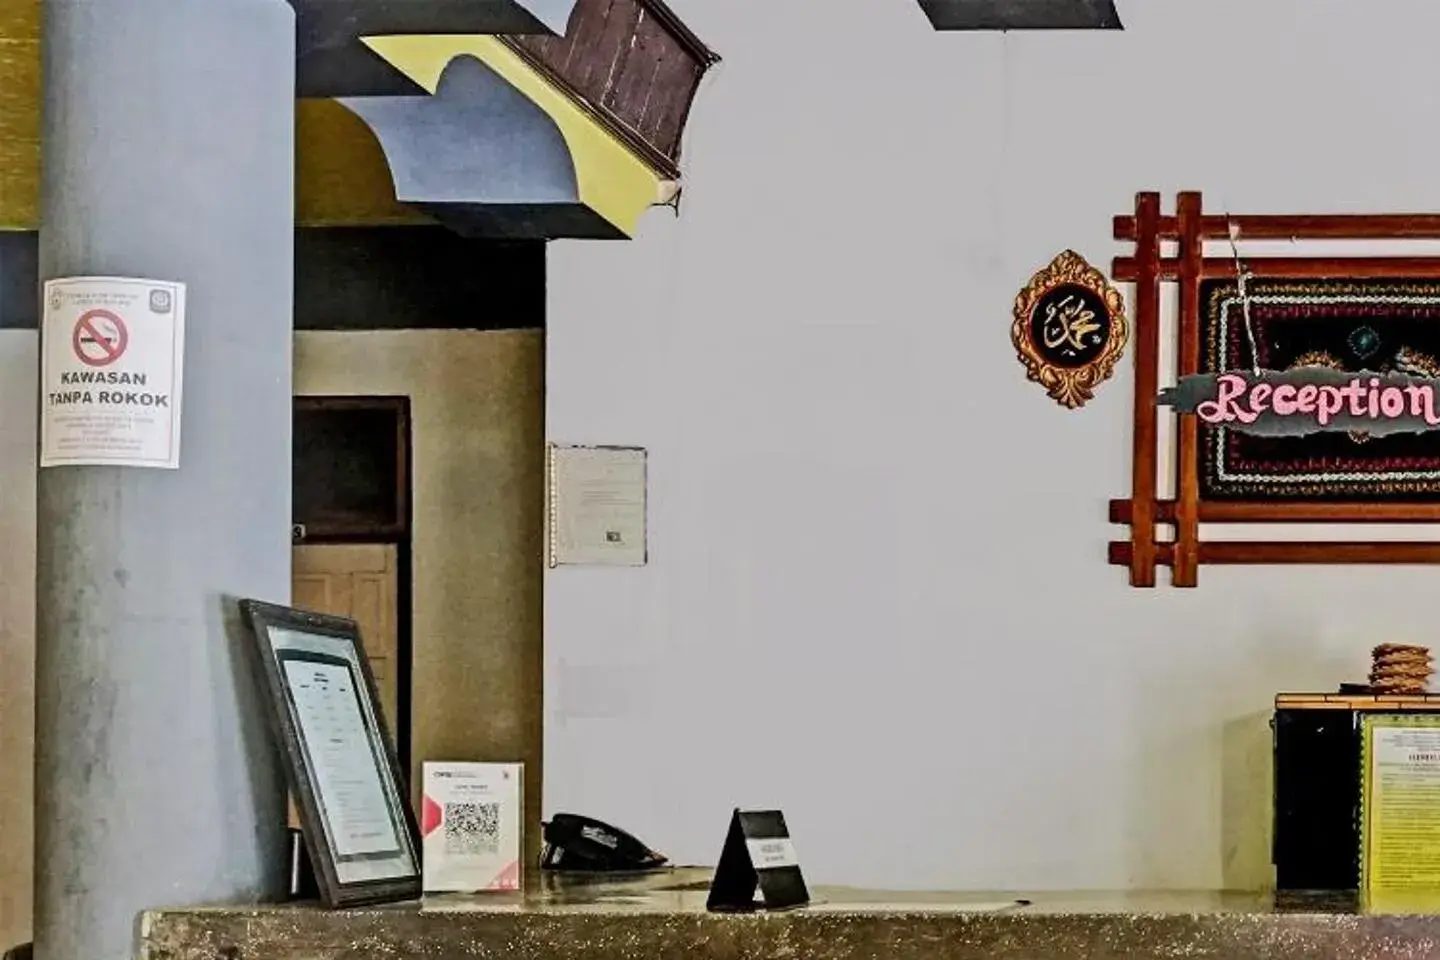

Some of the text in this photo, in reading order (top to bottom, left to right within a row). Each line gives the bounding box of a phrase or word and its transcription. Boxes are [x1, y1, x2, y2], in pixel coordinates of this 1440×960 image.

[61, 371, 147, 385] KAWASAN
[49, 391, 168, 407] TANPA ROKOK
